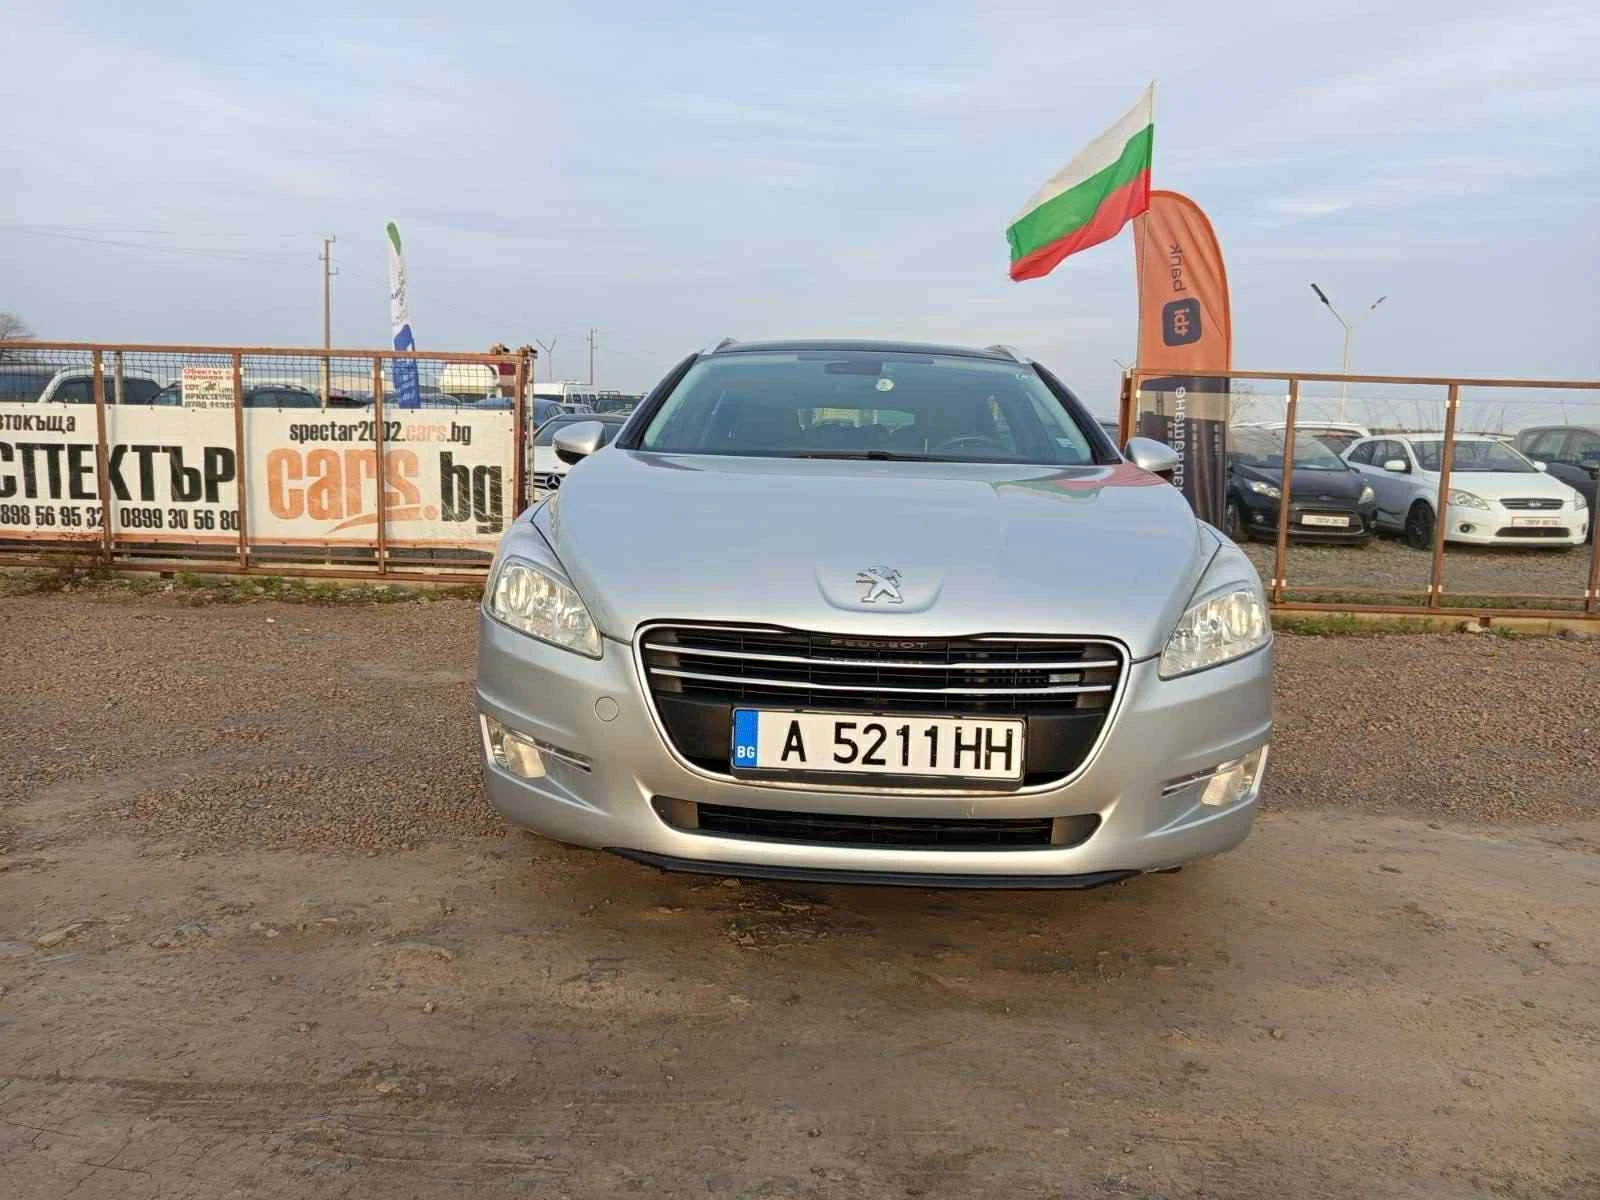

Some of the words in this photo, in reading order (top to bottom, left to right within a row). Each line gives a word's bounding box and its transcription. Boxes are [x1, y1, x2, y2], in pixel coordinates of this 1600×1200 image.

[35, 506, 56, 526] 56
[60, 506, 81, 527] 95
[120, 507, 163, 529] 0899
[168, 509, 188, 529] 30
[194, 509, 215, 530] 56
[220, 510, 240, 531] 80
[831, 640, 928, 649] PEUGEOT
[737, 746, 755, 759] BG
